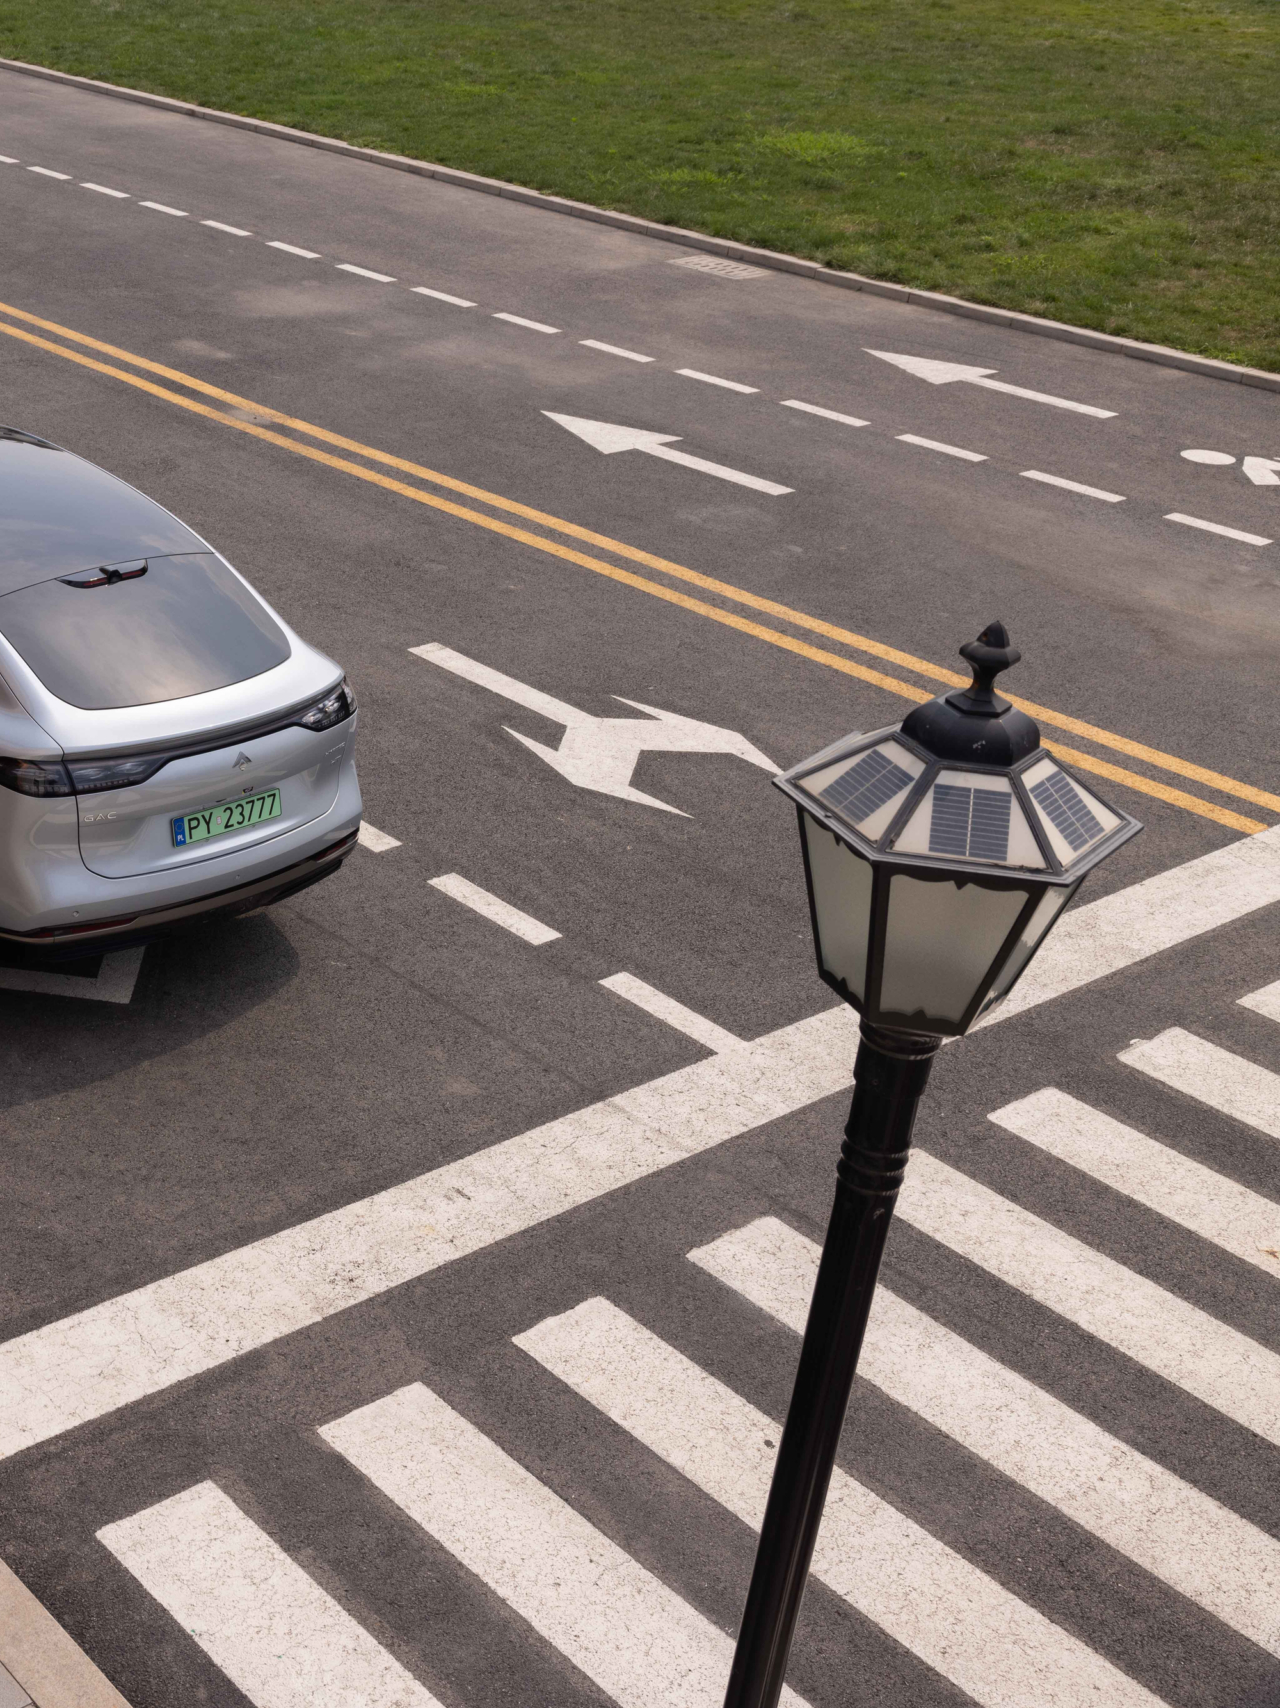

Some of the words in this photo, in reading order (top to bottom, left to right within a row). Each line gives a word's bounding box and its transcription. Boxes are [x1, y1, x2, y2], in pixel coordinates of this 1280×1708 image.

[84, 811, 117, 822] GAC
[188, 812, 213, 839] PY
[223, 793, 276, 829] 23777
[177, 834, 185, 842] PL
